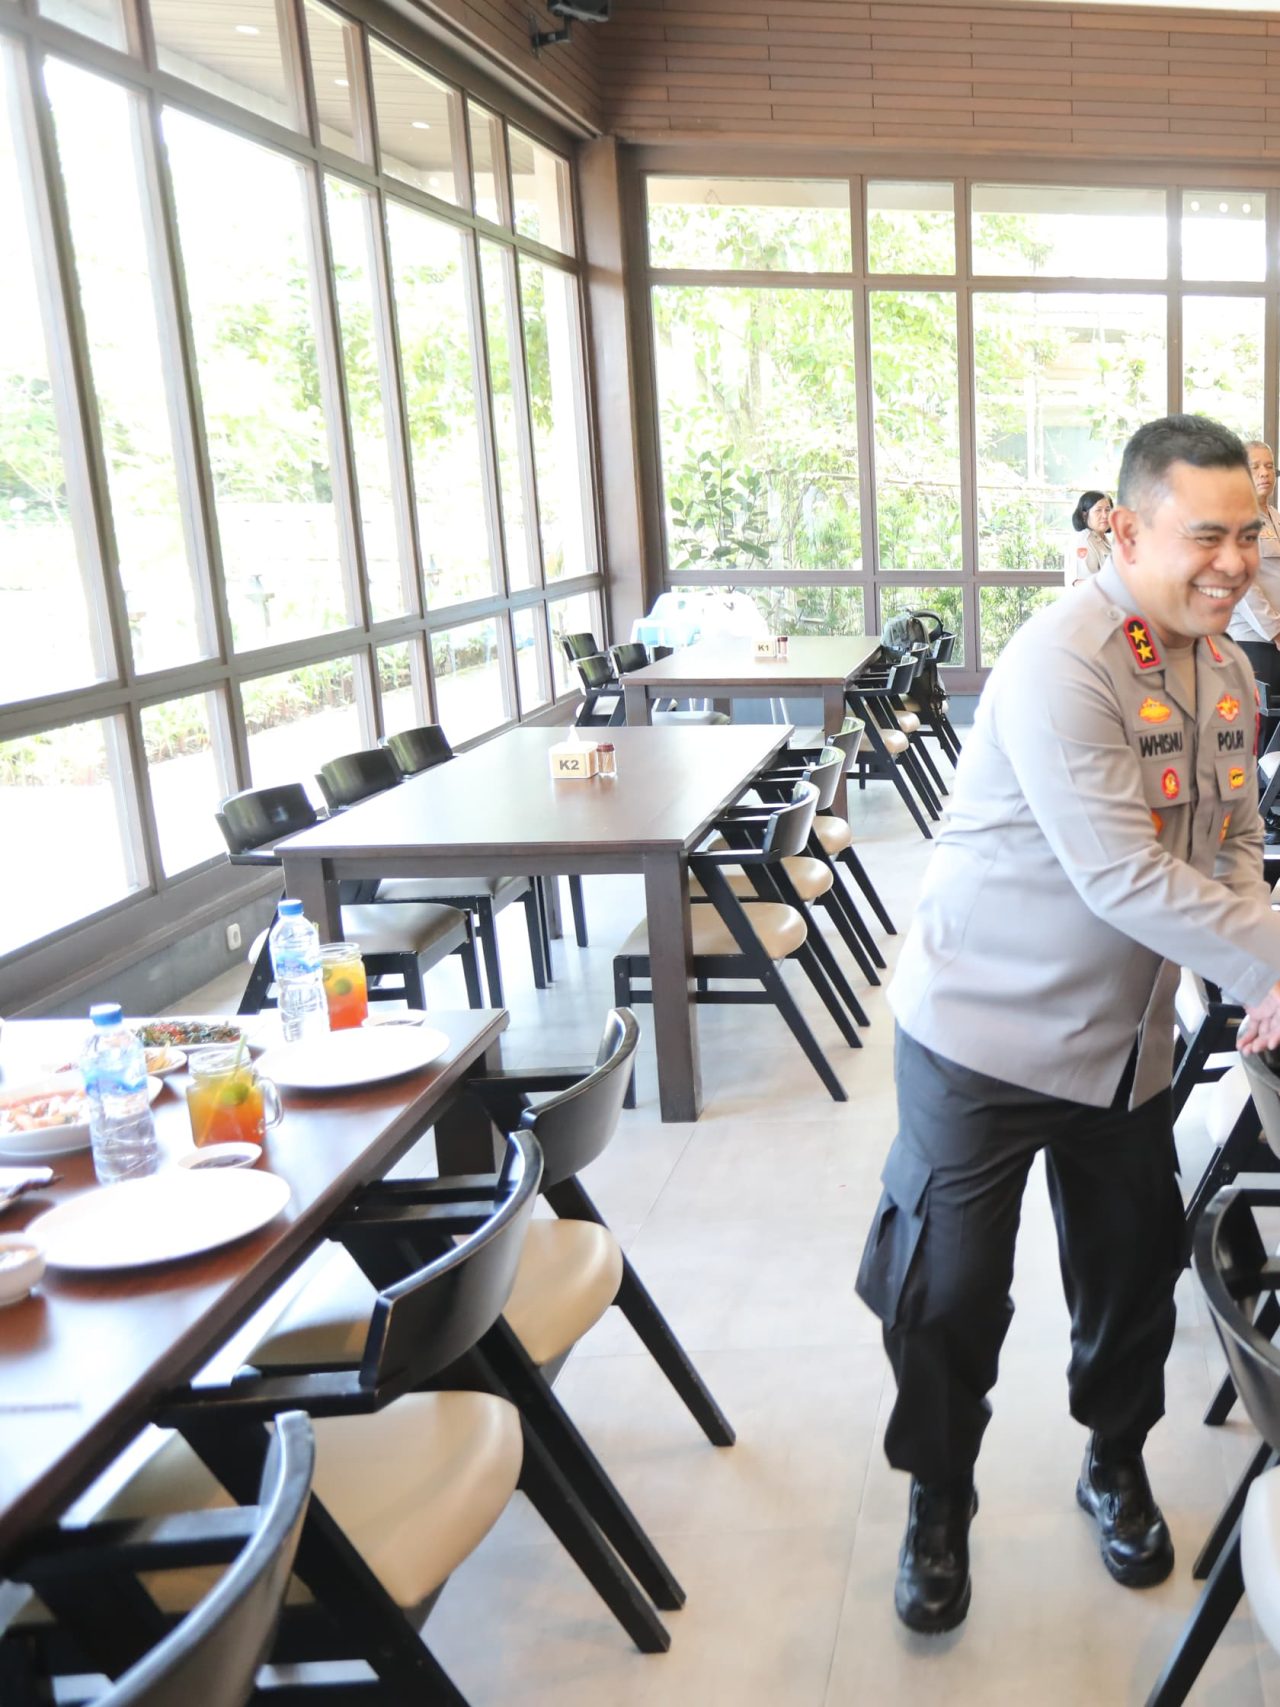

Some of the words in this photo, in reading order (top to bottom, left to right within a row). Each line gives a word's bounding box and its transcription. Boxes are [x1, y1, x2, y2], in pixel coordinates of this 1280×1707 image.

[1139, 731, 1183, 758] WHISNU
[1217, 729, 1244, 752] POLRI
[559, 759, 579, 771] K2
